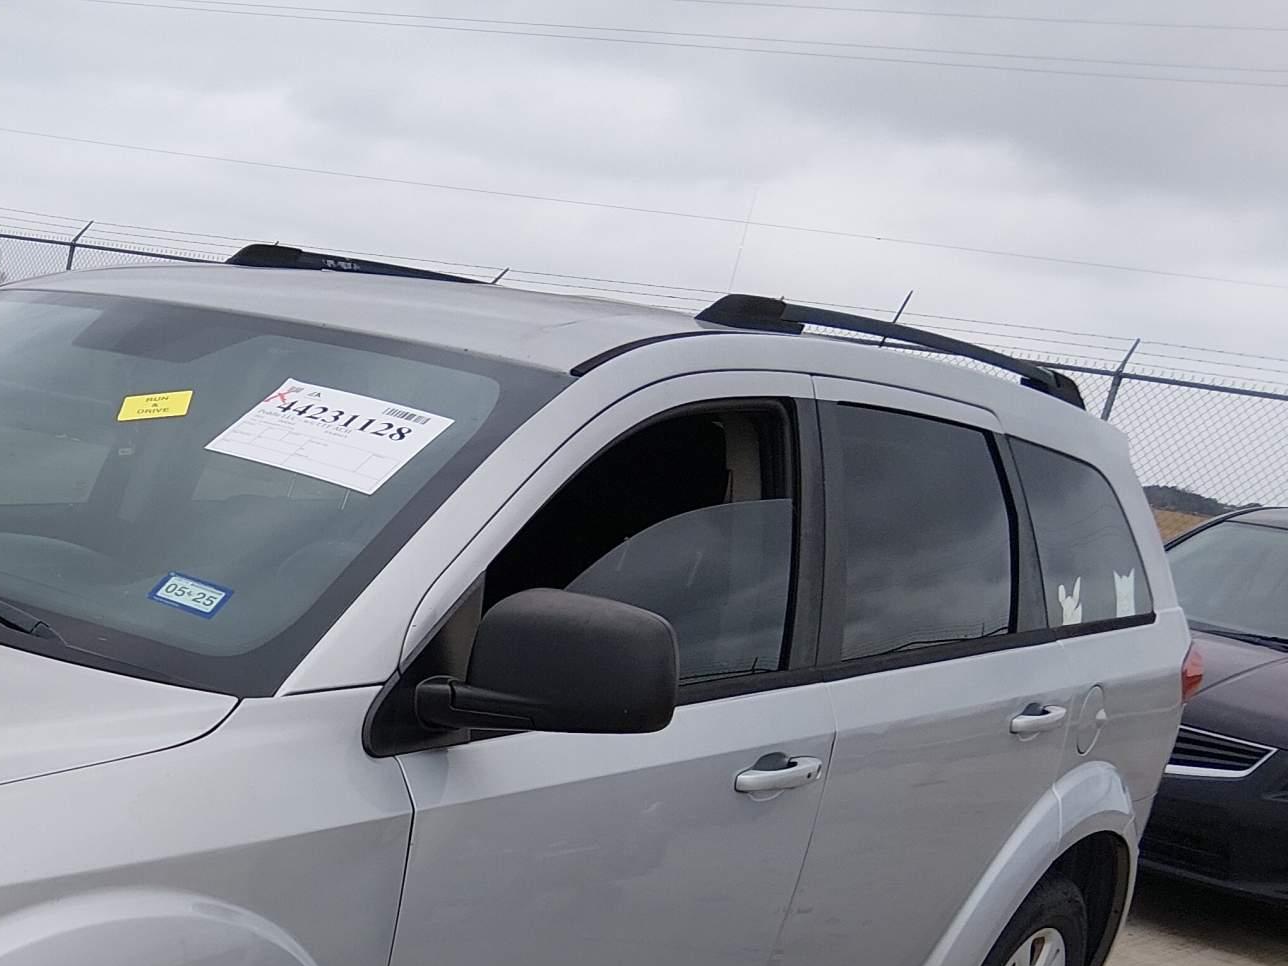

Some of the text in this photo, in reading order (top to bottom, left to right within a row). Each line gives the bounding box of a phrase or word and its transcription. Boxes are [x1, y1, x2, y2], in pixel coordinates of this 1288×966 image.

[277, 400, 413, 442] 44231128
[165, 583, 189, 597] 05
[192, 592, 217, 606] 25
